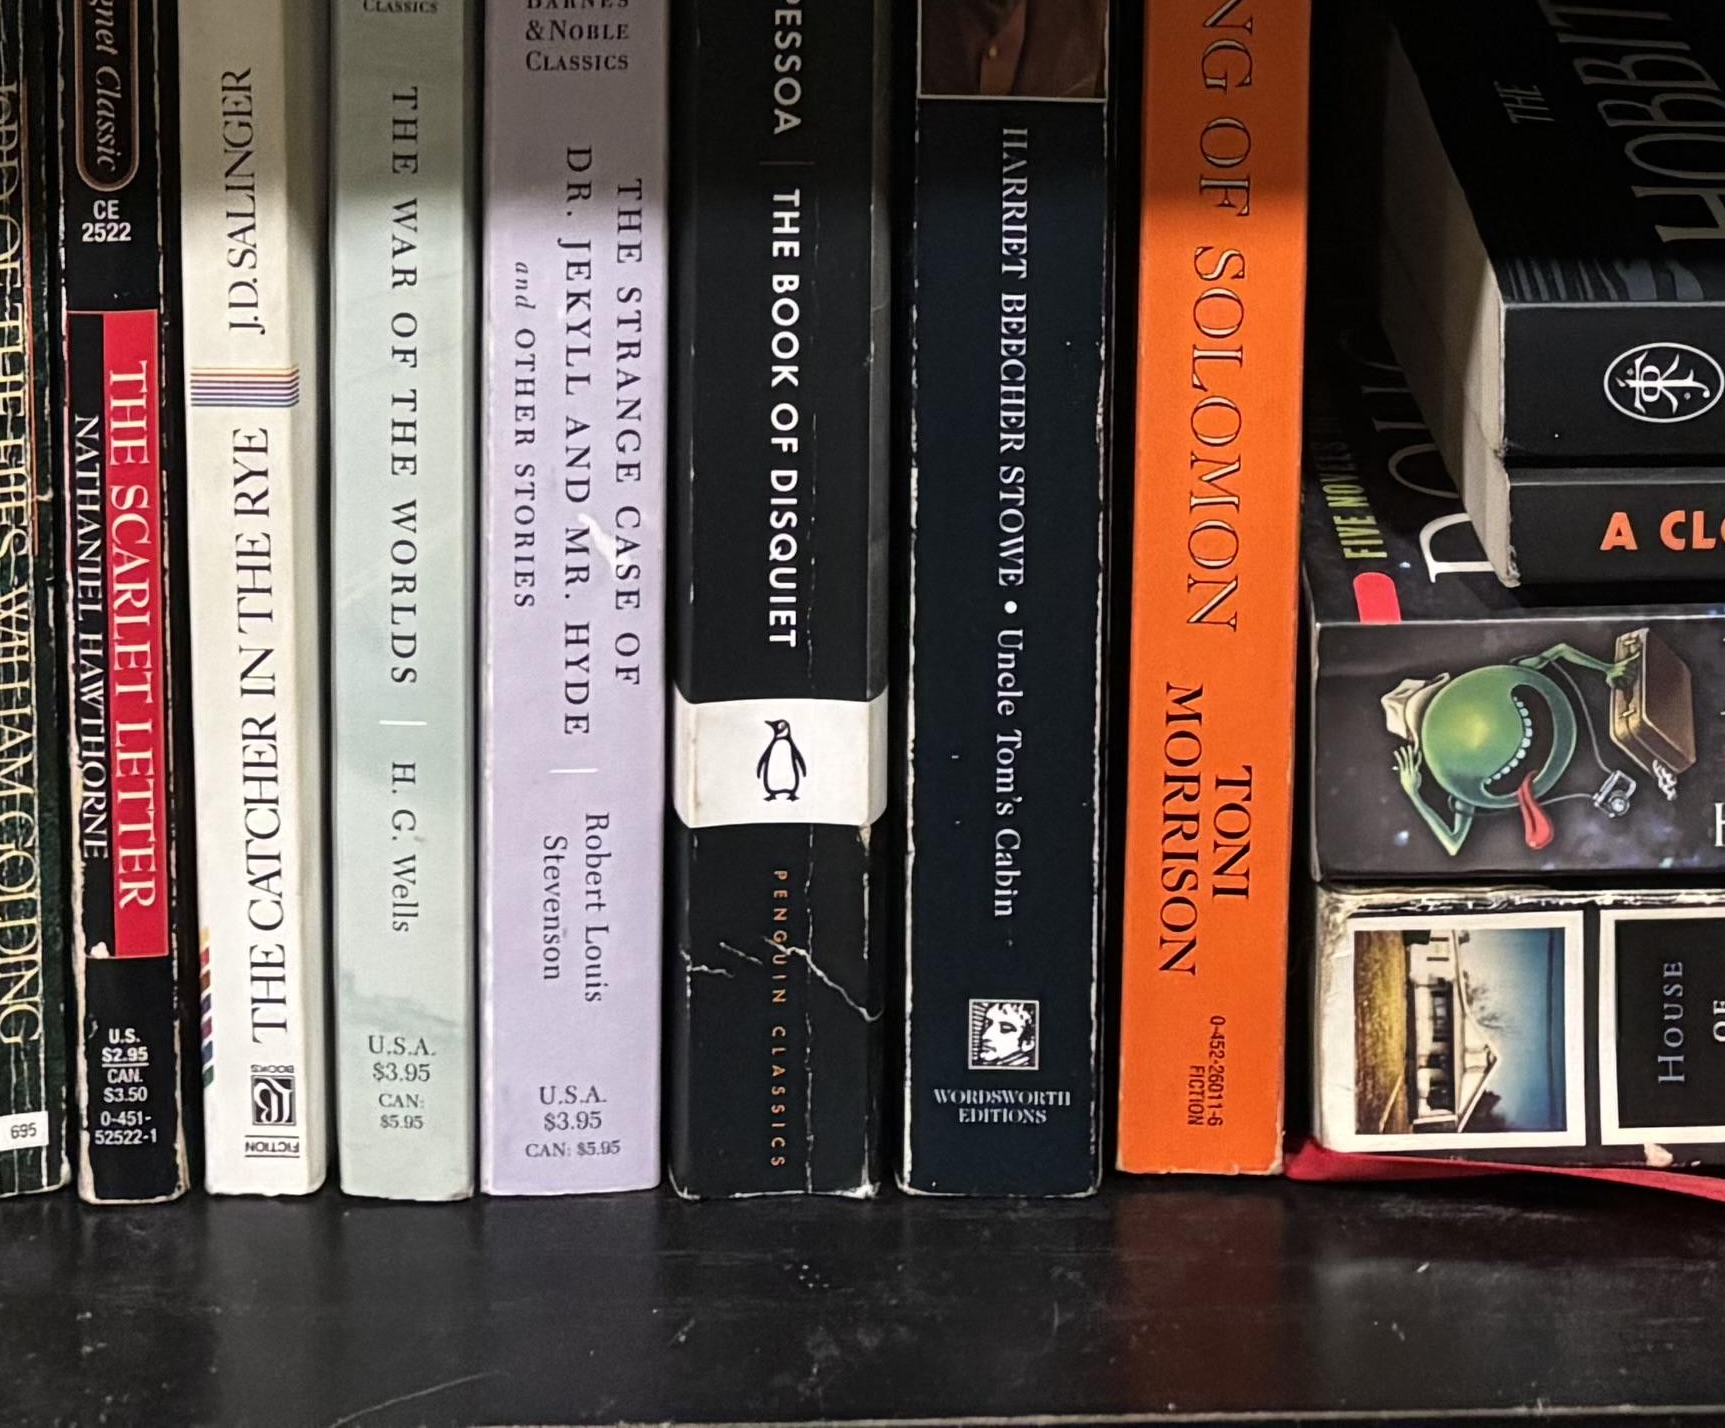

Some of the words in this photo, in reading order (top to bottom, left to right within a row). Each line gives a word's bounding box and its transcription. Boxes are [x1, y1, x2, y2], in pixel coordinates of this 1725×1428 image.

[391, 85, 419, 175] THE
[1198, 116, 1252, 217] OF
[391, 196, 419, 289] WAR
[771, 188, 801, 258] THE
[390, 311, 418, 369] OF
[770, 273, 801, 388] BOOK
[109, 360, 149, 466] THE
[390, 388, 418, 476] THE
[769, 402, 800, 454] OF
[1185, 245, 1246, 633] SOLOMON
[232, 427, 270, 517] RYE
[110, 484, 152, 667] SCARLET
[768, 468, 799, 648] DISQUIET
[1599, 511, 1638, 551] A
[234, 532, 274, 635] THE
[388, 499, 419, 686] WORLDS
[238, 645, 276, 697] IN
[114, 675, 156, 911] LETTER
[241, 713, 285, 932] CATCHER
[391, 761, 416, 795] H.
[391, 808, 417, 841] G.
[1159, 682, 1204, 976] MORRISON
[1211, 764, 1253, 899] TONI
[391, 853, 420, 933] Wells
[108, 1028, 141, 1044] U.S.
[248, 943, 288, 1044] THE
[1657, 961, 1686, 1083] HOUSE
[9, 1121, 38, 1140] 695
